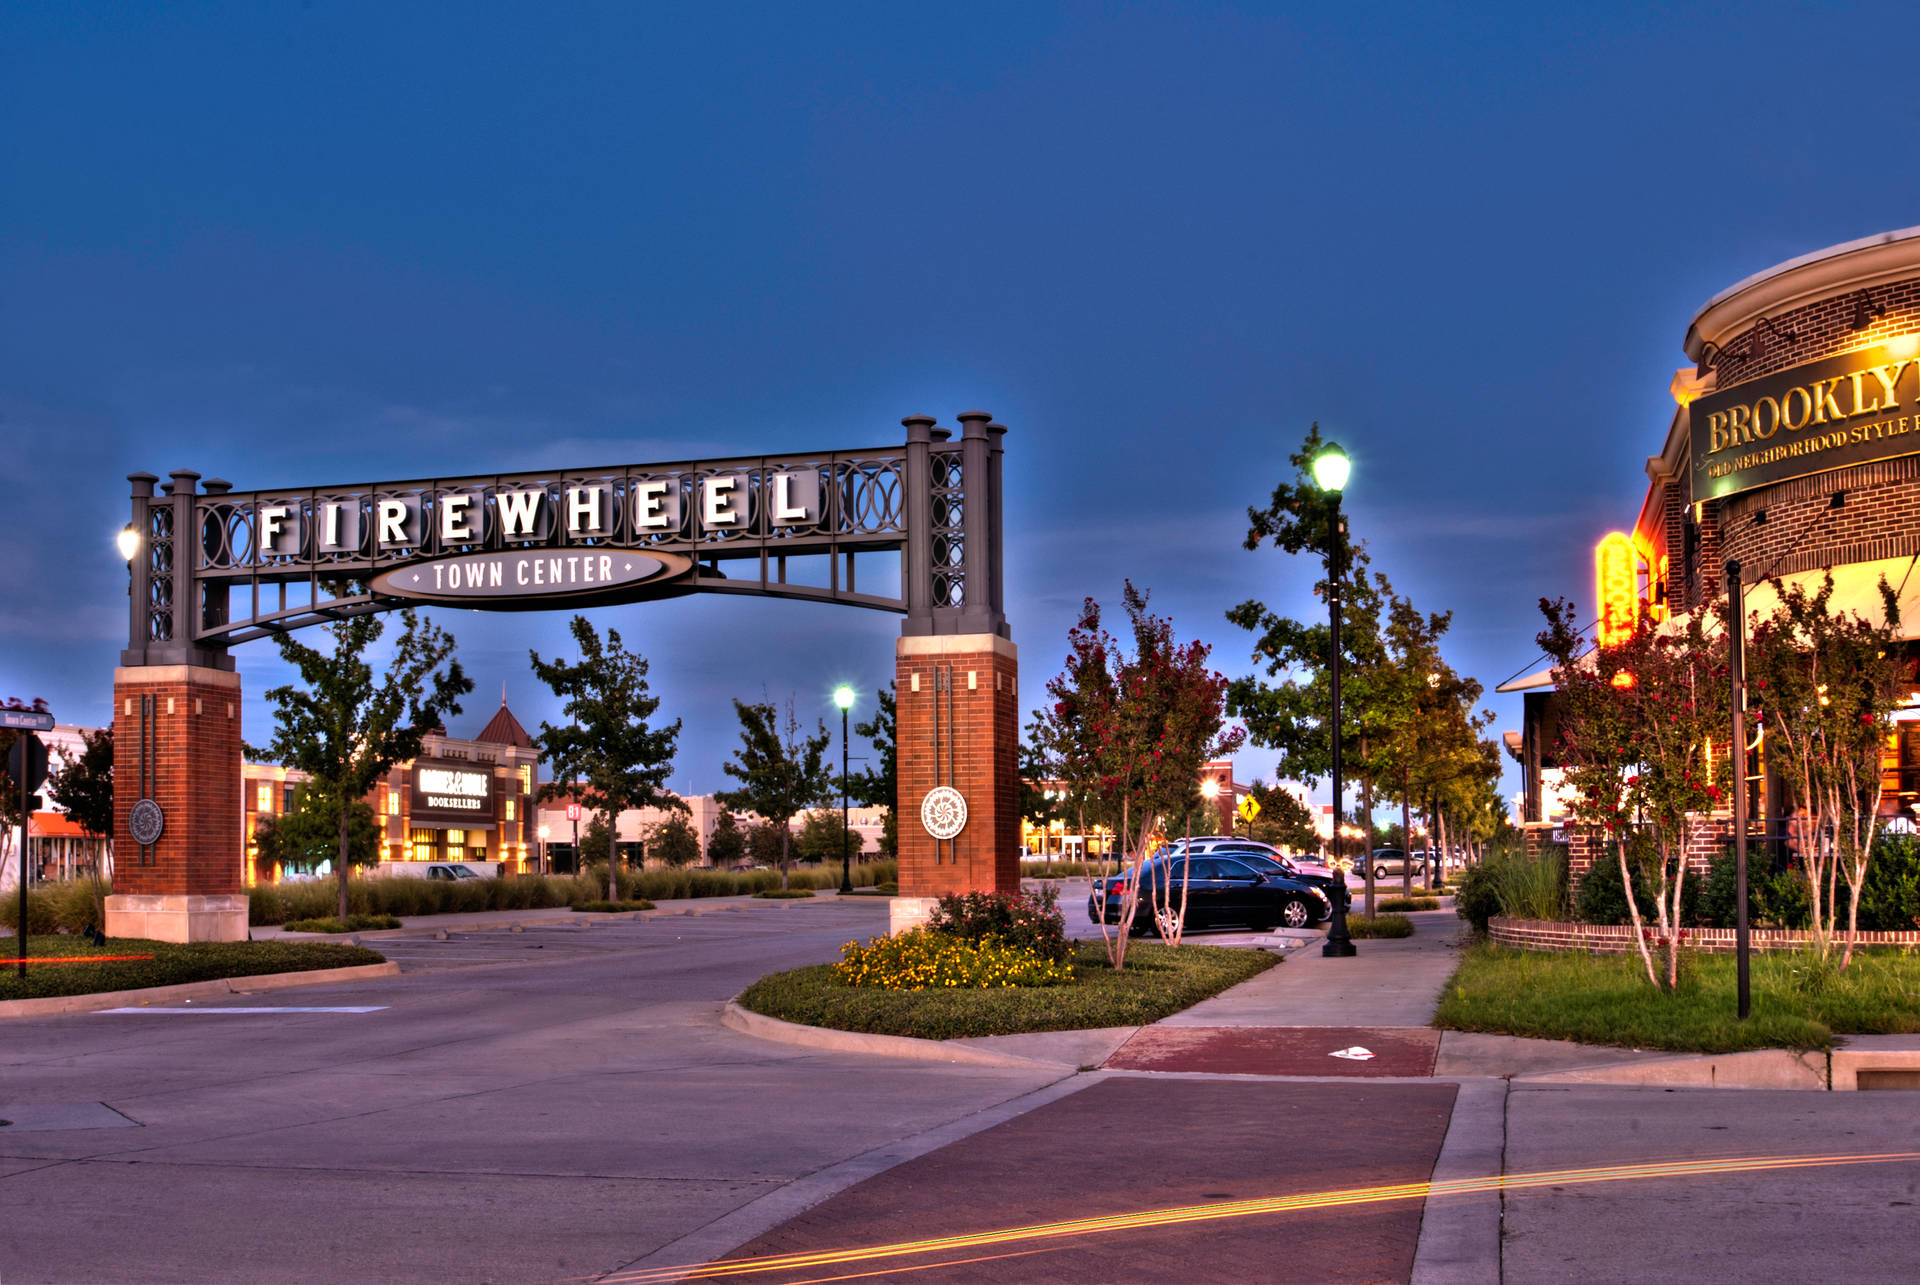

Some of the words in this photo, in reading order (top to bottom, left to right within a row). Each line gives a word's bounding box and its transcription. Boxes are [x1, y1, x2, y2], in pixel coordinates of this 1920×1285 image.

[1706, 358, 1920, 454] BROOKLY
[1709, 460, 1733, 478] OLD
[1734, 431, 1847, 472] NEIGHBORHOOD
[1851, 417, 1909, 443] STYLE
[260, 474, 807, 550] FIREWHEEL
[433, 561, 503, 590] TOWN
[517, 555, 613, 586] CENTER
[427, 796, 481, 810] BOOKSELLERS
